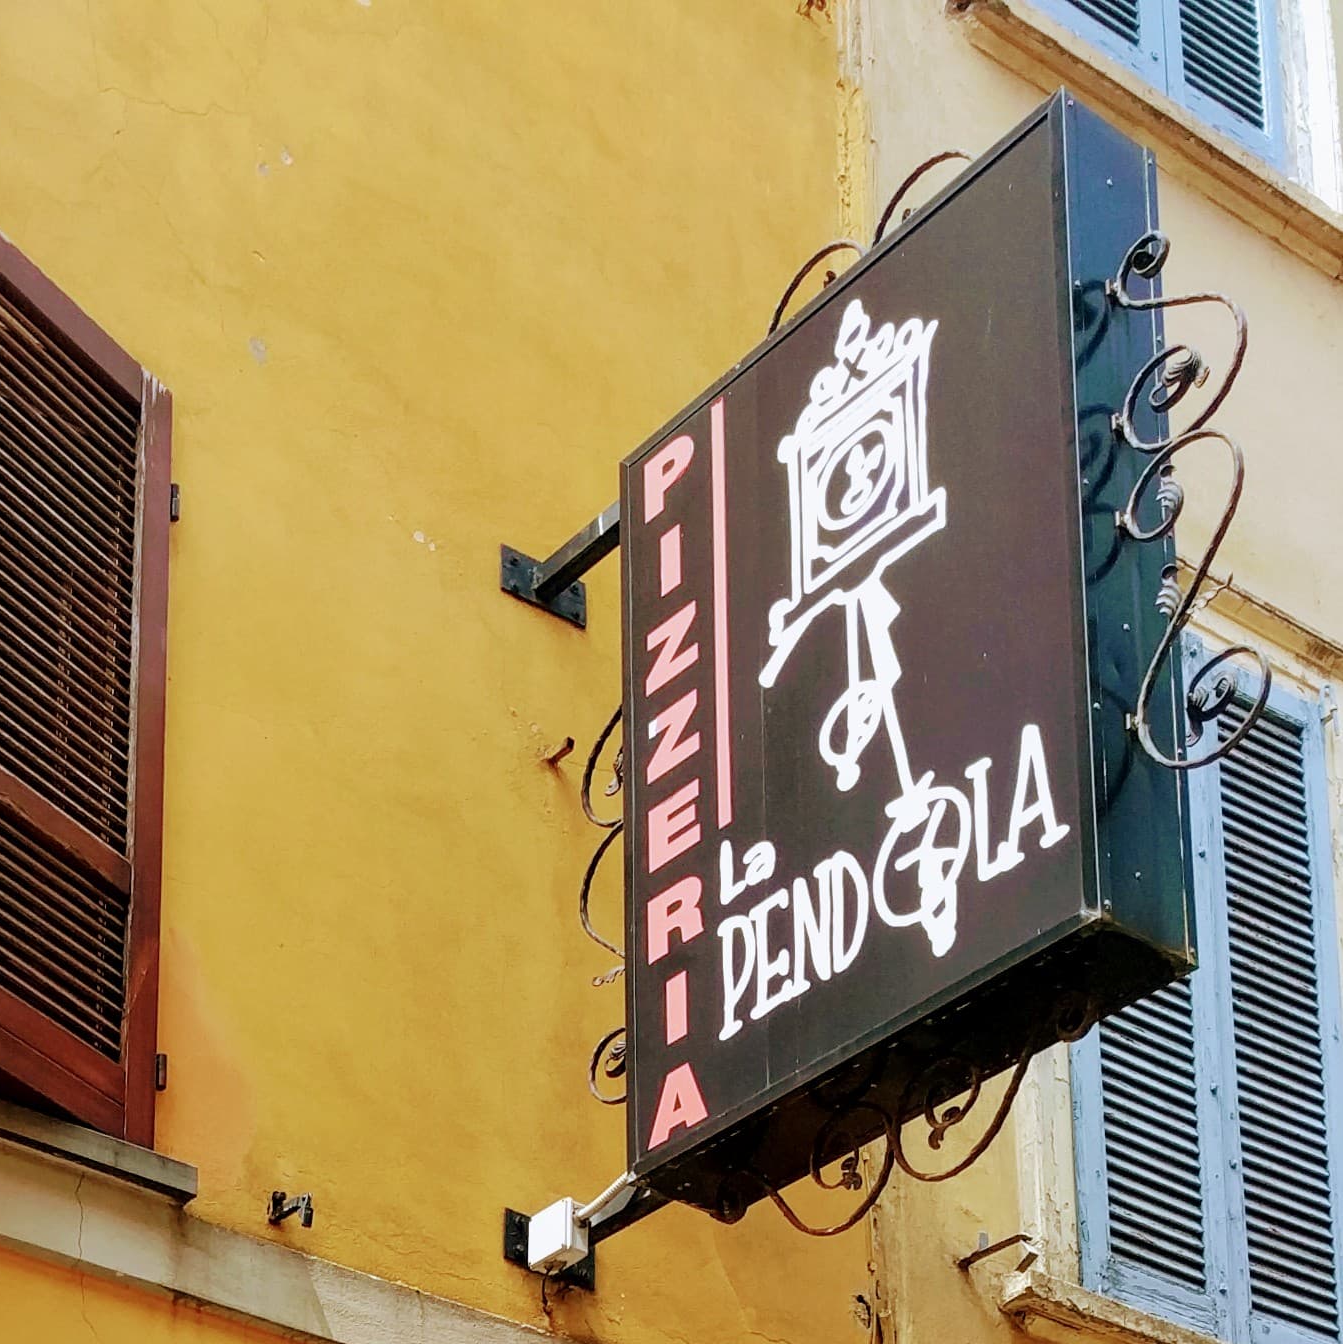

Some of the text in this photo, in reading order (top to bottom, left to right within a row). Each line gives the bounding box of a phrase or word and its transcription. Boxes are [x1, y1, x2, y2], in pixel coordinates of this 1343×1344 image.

[644, 434, 709, 1150] PIZZERIA
[717, 724, 1070, 1041] PENDOLA
[719, 839, 776, 905] La
